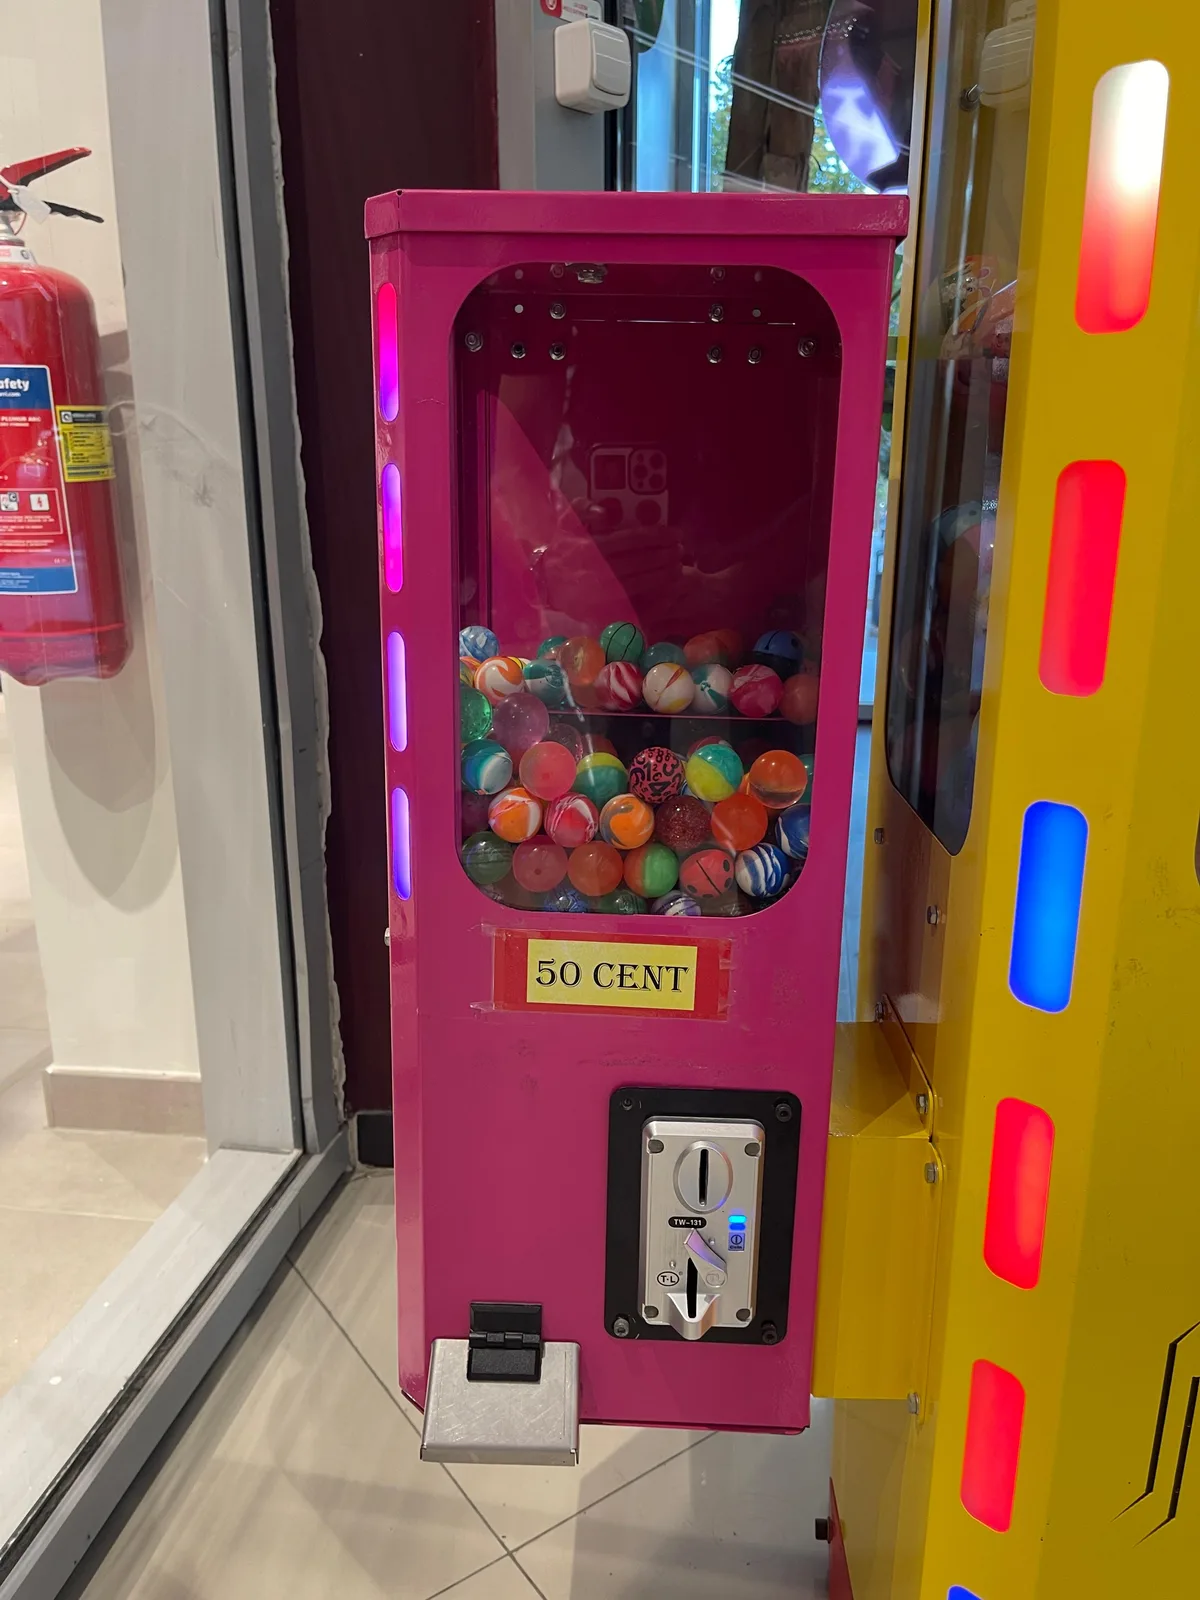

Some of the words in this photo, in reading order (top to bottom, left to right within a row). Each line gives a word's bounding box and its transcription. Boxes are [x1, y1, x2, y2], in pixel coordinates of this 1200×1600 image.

[535, 958, 583, 987] 50
[593, 962, 689, 993] CENT
[673, 1218, 702, 1226] TW-131
